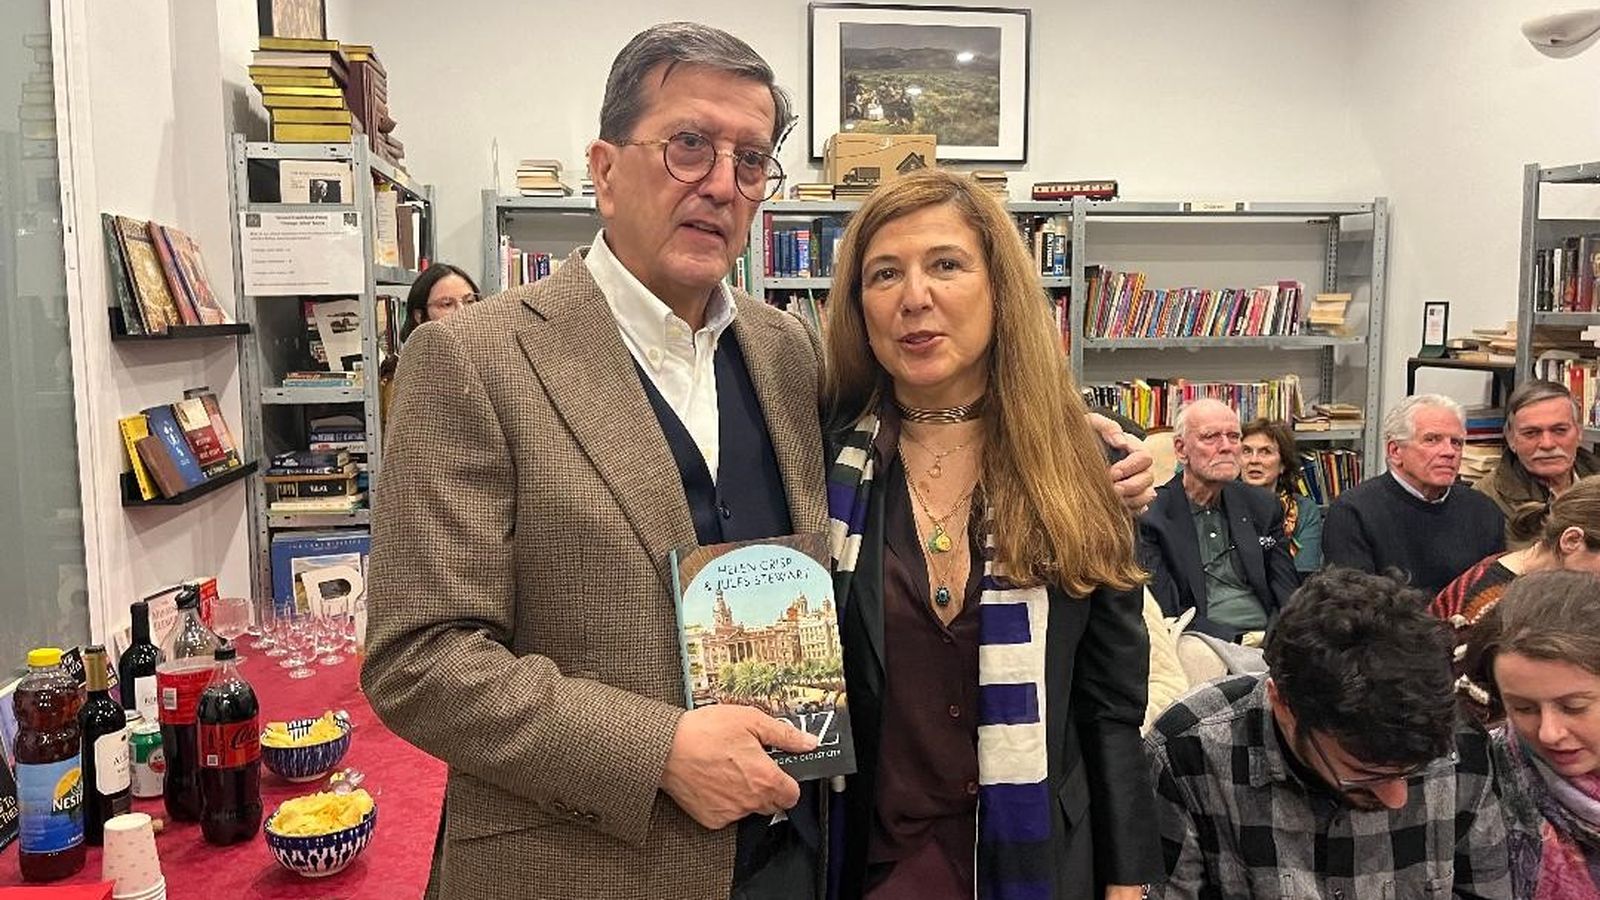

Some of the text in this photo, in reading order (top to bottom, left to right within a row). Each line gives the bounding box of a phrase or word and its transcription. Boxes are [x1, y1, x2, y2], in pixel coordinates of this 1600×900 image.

[718, 557, 792, 575] HELEN CRISP
[717, 576, 751, 589] JULES
[755, 567, 810, 585] STEWART
